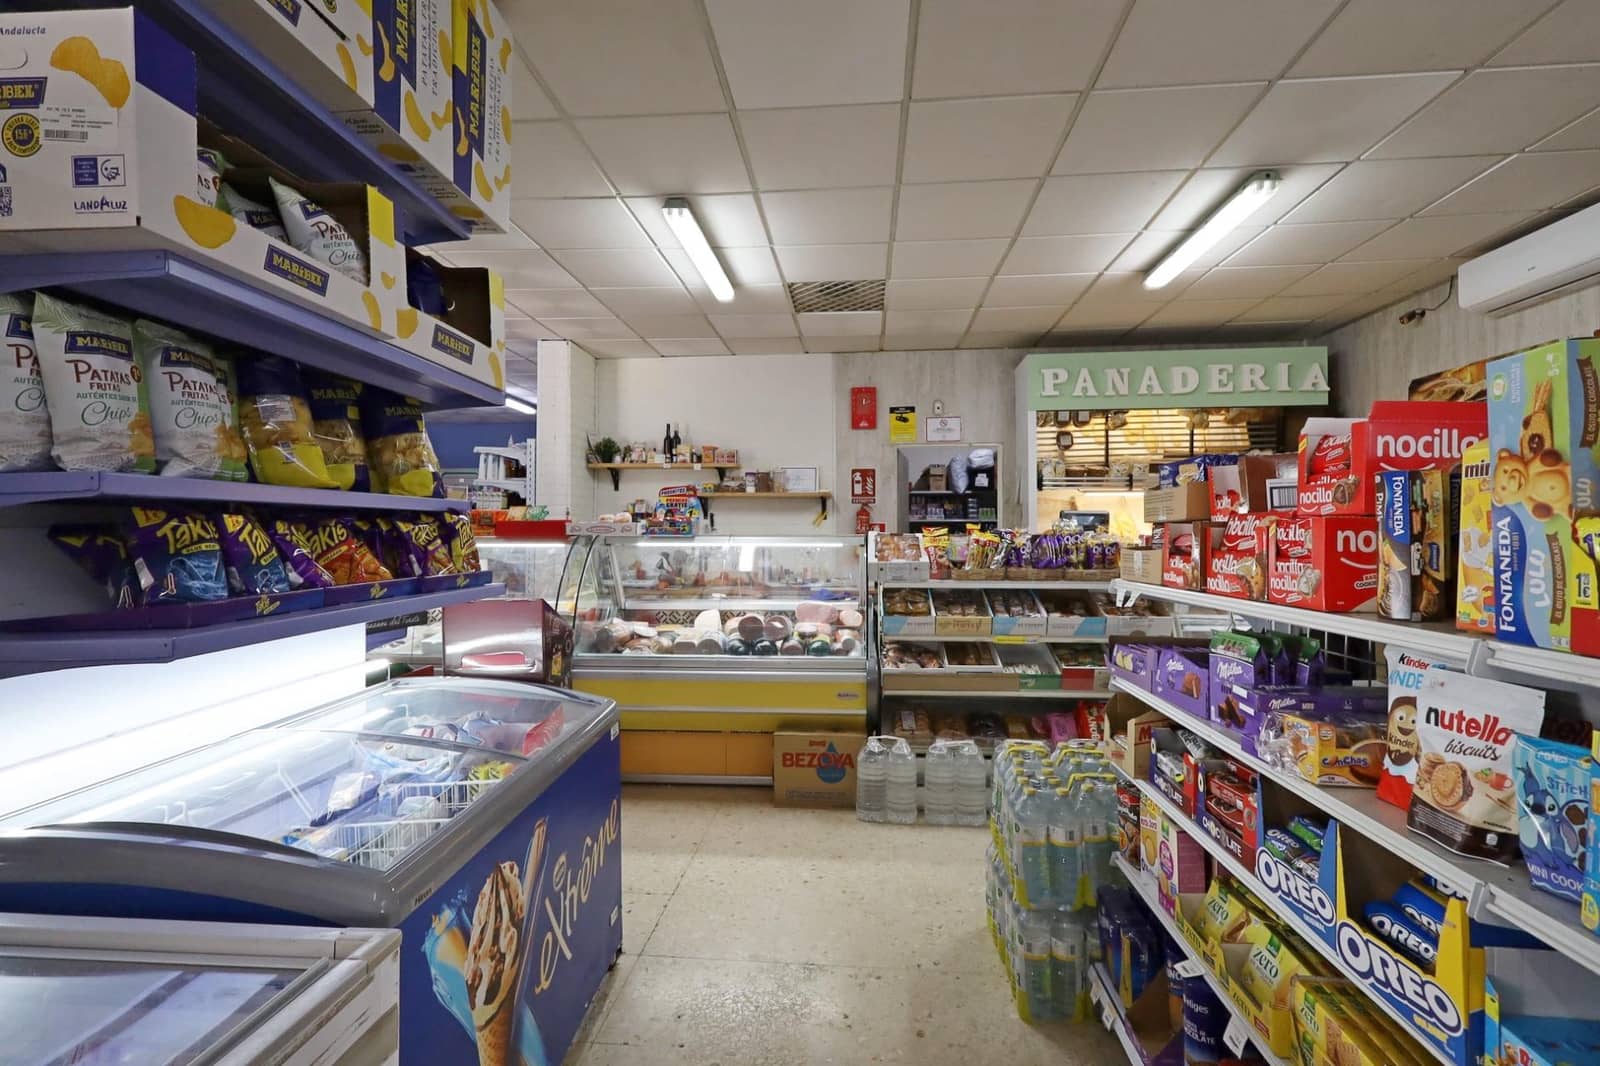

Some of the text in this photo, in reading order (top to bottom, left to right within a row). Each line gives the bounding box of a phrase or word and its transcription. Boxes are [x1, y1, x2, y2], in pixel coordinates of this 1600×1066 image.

[65, 360, 131, 385] PATATAS
[1040, 361, 1330, 398] PANADERIA
[89, 382, 121, 392] FRITAS
[181, 391, 209, 400] FRITAS
[81, 401, 131, 426] Chips
[1300, 487, 1333, 504] nocilla
[1391, 475, 1406, 537] FONTANEDA
[1270, 576, 1298, 590] nocilla
[1496, 516, 1517, 632] FONTANEDA
[1217, 661, 1243, 680] Milka
[1398, 652, 1430, 671] Kinder
[1268, 697, 1297, 710] Milka
[1425, 705, 1514, 746] nutella
[1389, 733, 1415, 750] Kinder
[1444, 738, 1503, 762] biscuits
[782, 753, 855, 768] BEZOYA
[1266, 828, 1300, 849] OREO
[1257, 847, 1336, 927] OREO
[1370, 914, 1436, 961] OREO
[1338, 920, 1464, 1037] OREO
